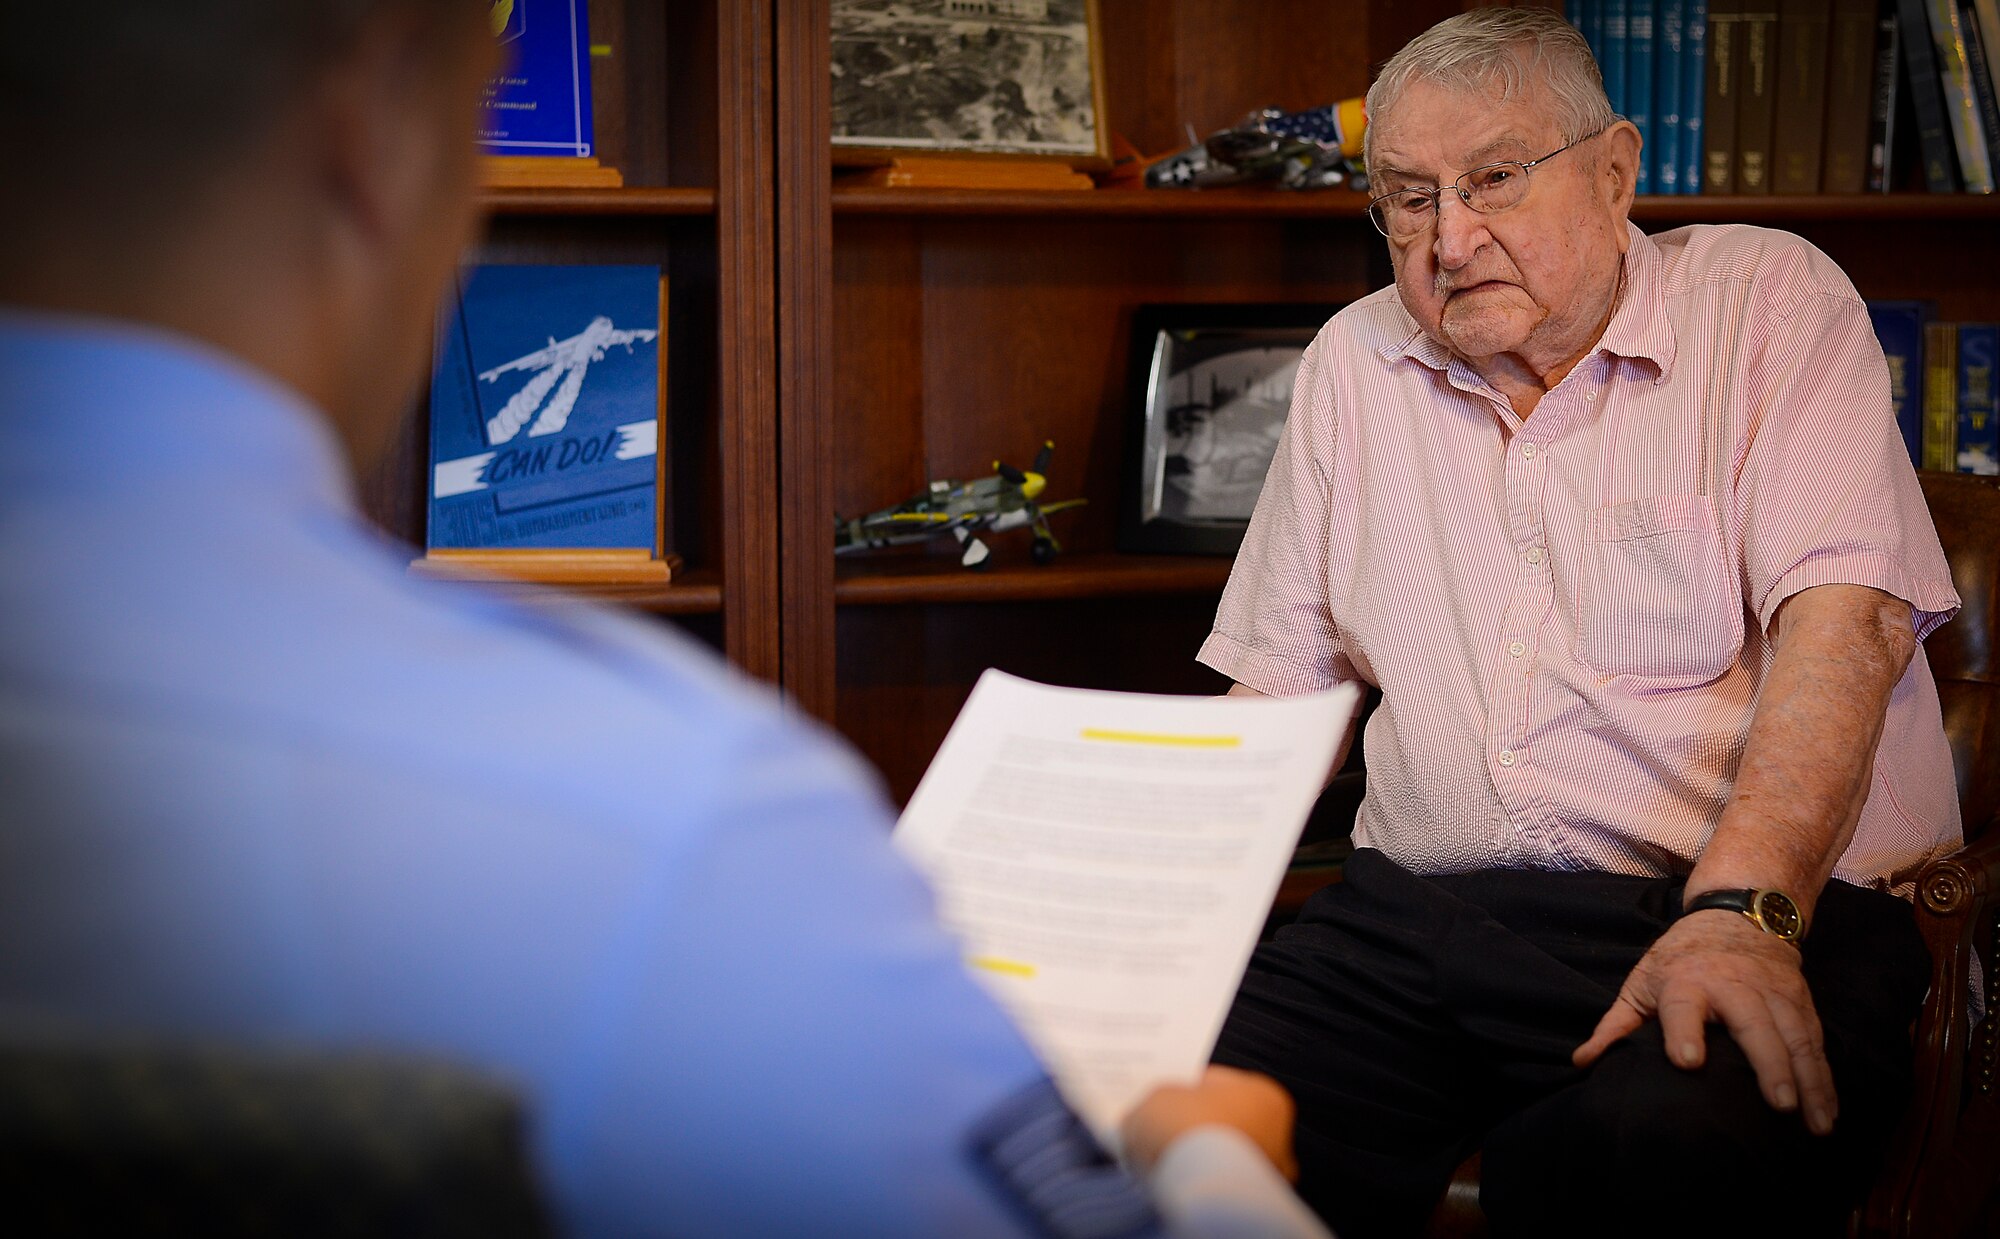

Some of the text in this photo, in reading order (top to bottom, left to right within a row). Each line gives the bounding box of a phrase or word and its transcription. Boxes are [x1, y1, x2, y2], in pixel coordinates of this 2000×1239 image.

[486, 101, 537, 110] Command
[491, 431, 616, 483] CAN DO!
